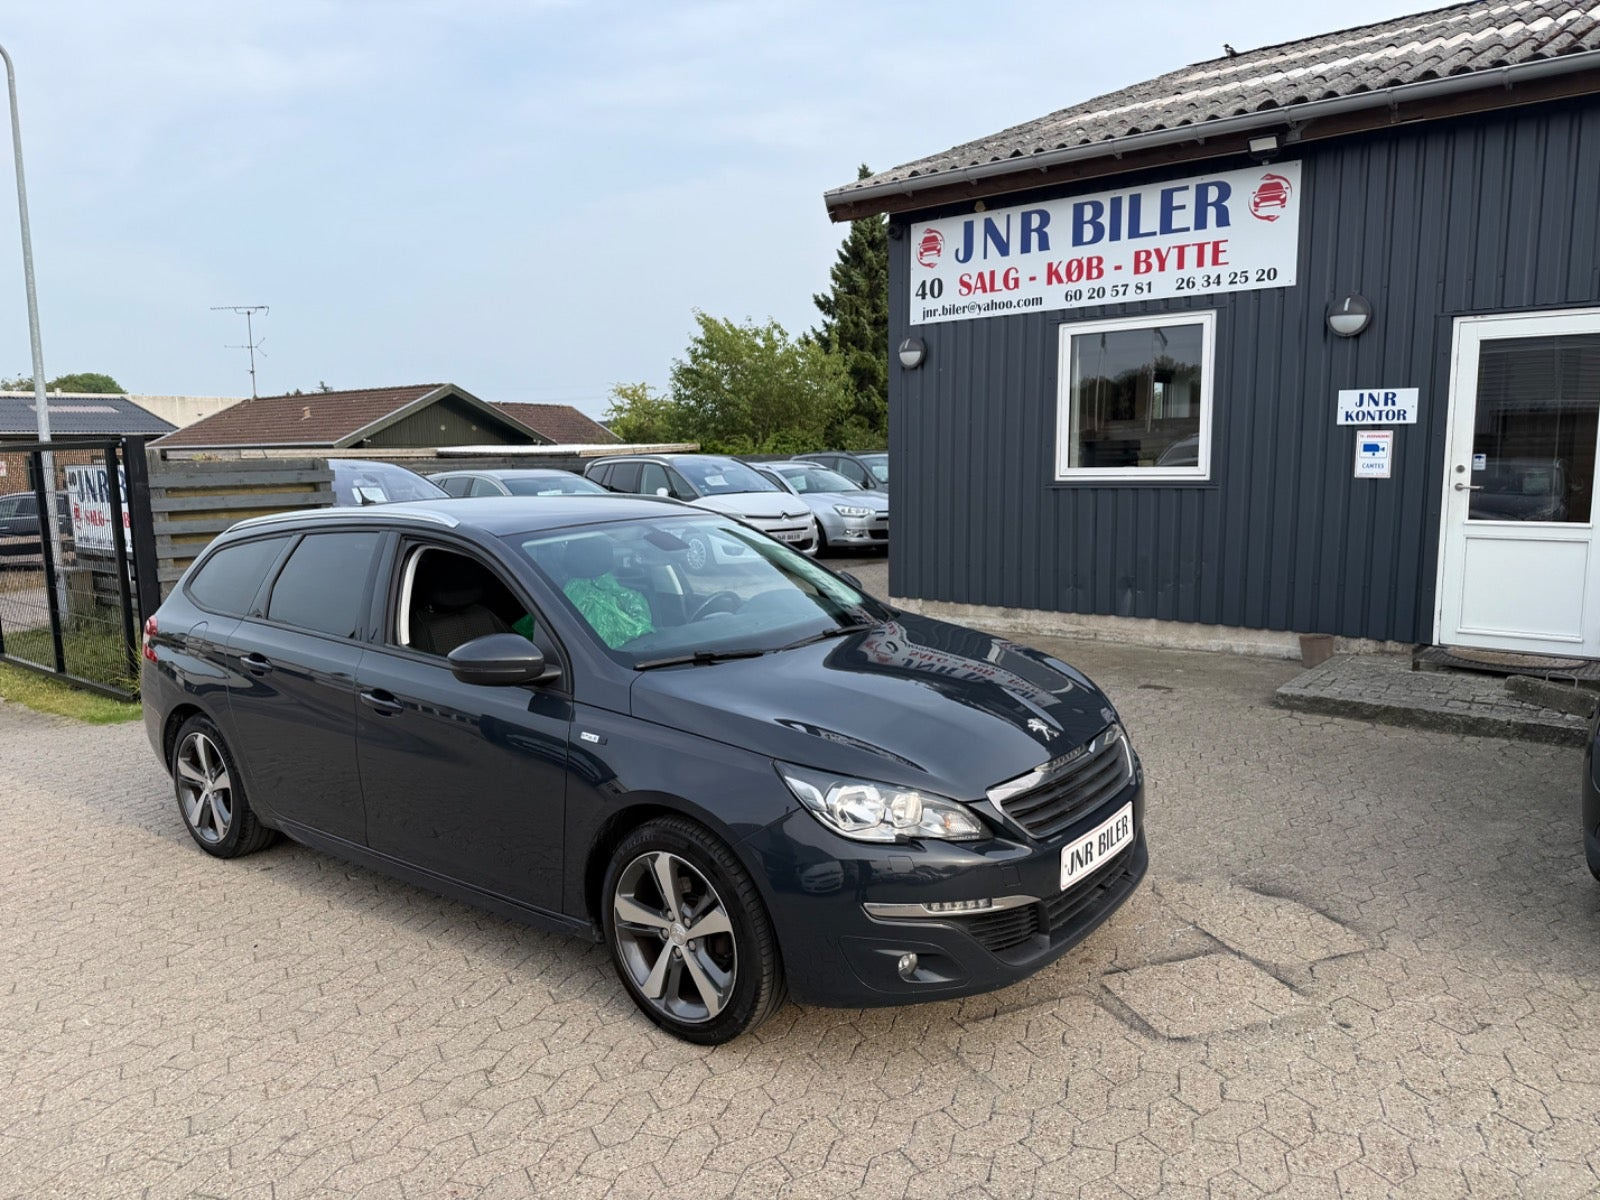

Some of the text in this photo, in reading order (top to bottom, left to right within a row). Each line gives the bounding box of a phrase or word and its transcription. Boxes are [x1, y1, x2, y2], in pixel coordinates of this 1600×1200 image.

[955, 180, 1232, 264] JNR BILER
[958, 267, 1020, 296] SALG
[1046, 255, 1104, 286] KØB
[1133, 239, 1230, 276] BYTTE
[1175, 267, 1278, 291] 26 34 25 20
[915, 277, 944, 301] 40
[1065, 281, 1152, 302] 60 20 57 81
[922, 296, 1043, 320] jnr.biler@yahoo.com
[1355, 391, 1397, 408] JNR
[1345, 409, 1407, 422] KONTOR
[1068, 814, 1129, 876] JNR BILER
